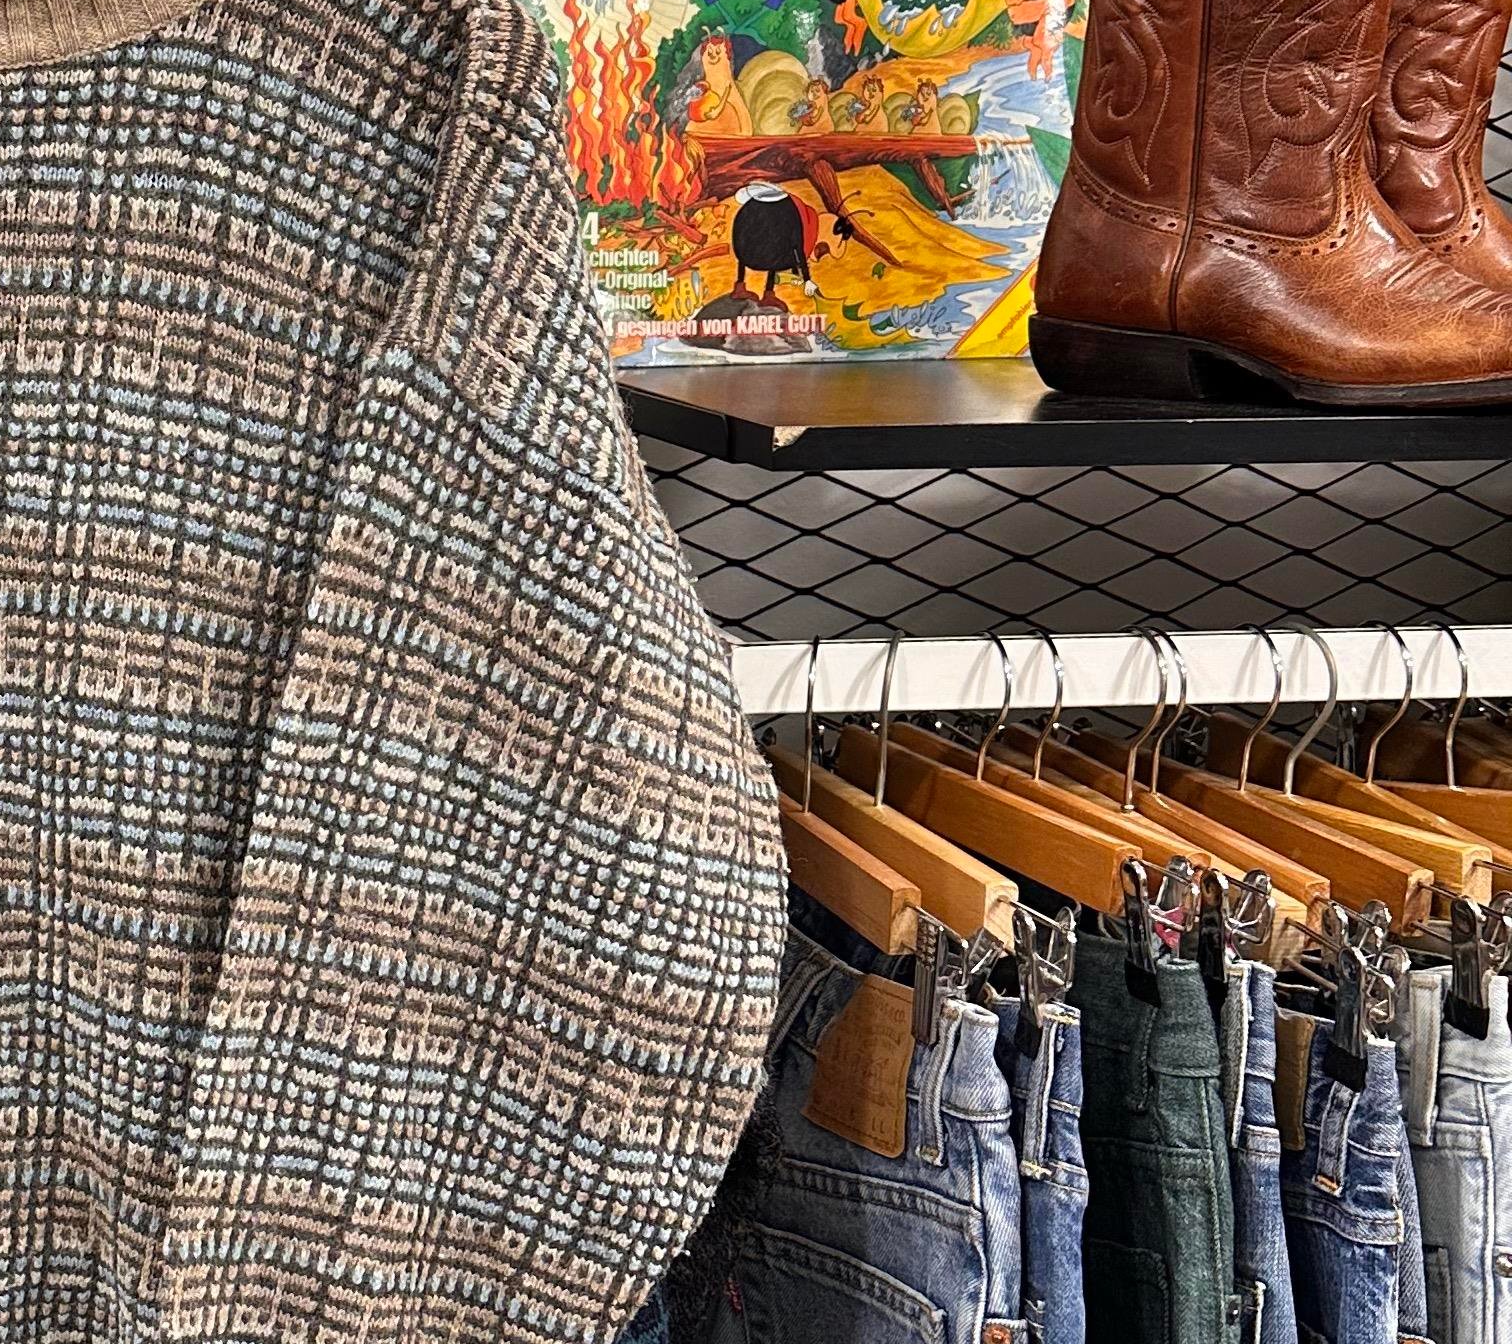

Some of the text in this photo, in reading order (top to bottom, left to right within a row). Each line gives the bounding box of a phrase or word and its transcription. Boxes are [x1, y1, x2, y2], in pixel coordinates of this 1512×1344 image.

[589, 248, 659, 267] chichten
[617, 318, 698, 338] gesungen
[702, 318, 732, 335] von
[736, 314, 783, 334] KAREL
[787, 313, 828, 332] GOTT
